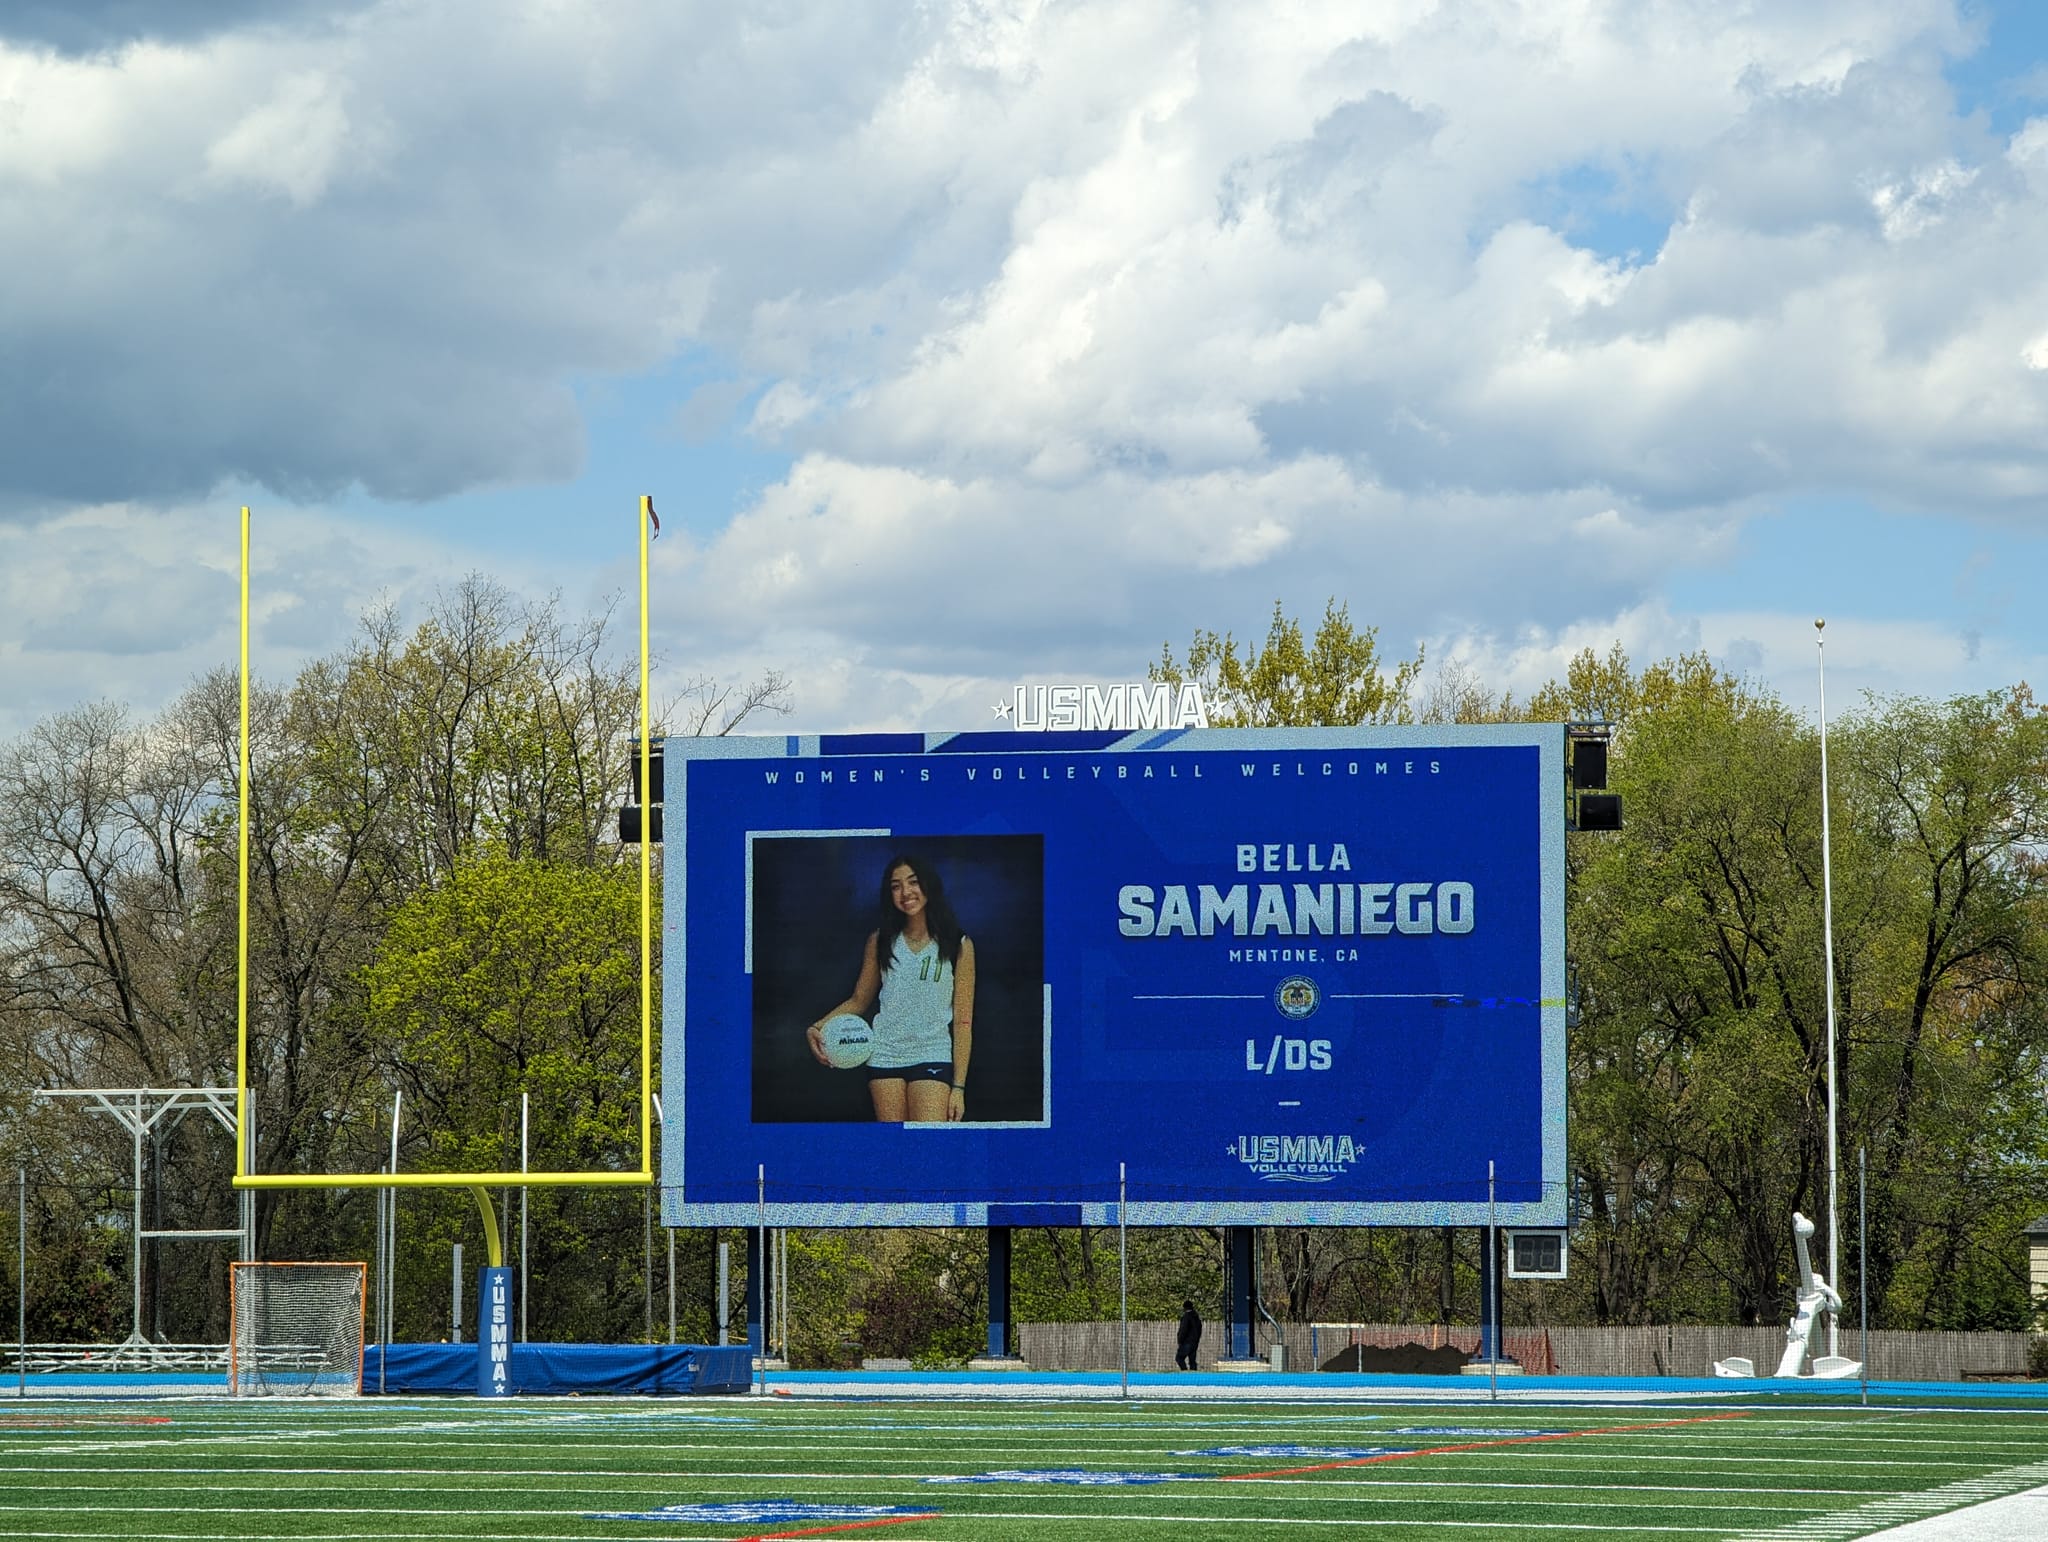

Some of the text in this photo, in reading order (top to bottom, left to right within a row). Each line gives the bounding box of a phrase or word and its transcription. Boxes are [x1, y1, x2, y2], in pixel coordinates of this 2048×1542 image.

[1013, 683, 1209, 732] USMMA
[766, 762, 1440, 784] WOMEN'S VOLLEYBALL WELCOMES
[1237, 844, 1350, 872] BELLA
[1118, 881, 1474, 937] SAMANIEGO
[1229, 949, 1358, 963] MENTONE, CA
[1246, 1035, 1332, 1075] L/DS
[1239, 1135, 1356, 1163] USMMA
[1249, 1164, 1347, 1173] VOLLEYBALL
[491, 1286, 506, 1381] USMMA
